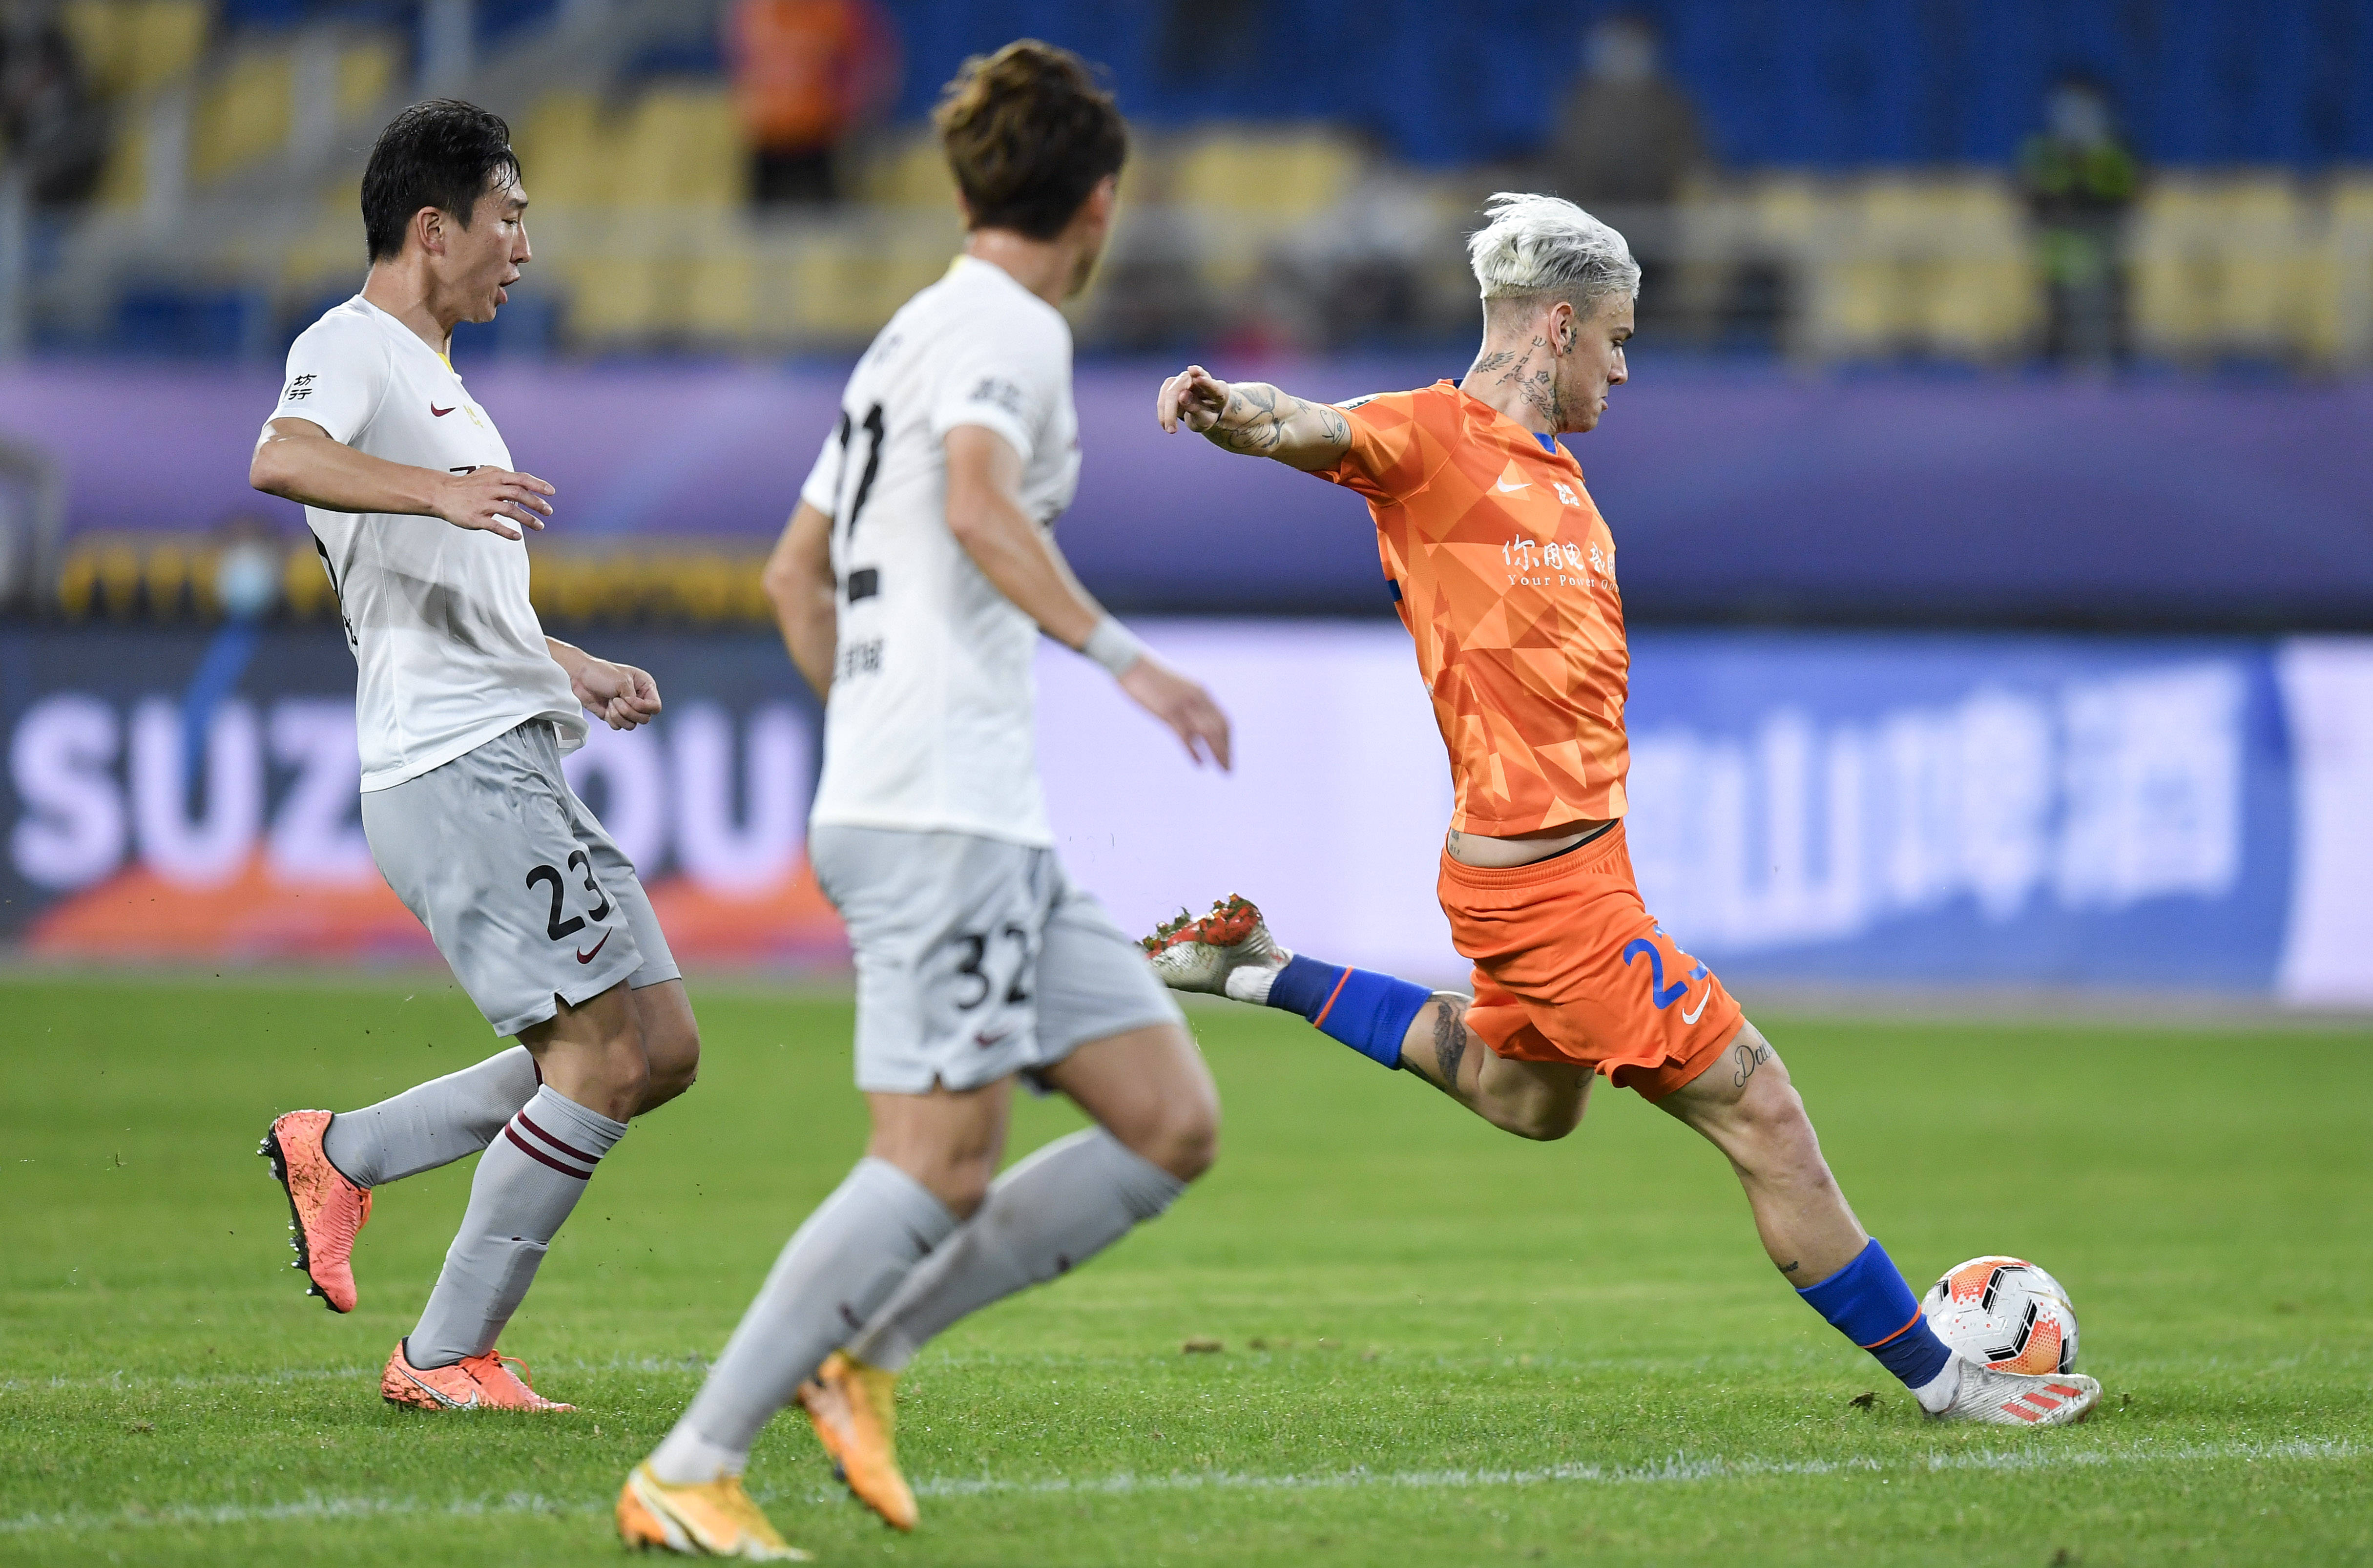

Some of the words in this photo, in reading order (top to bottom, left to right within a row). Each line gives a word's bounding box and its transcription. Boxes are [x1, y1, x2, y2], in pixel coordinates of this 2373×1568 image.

[1507, 575, 1550, 585] Your
[1559, 575, 1595, 587] Power
[11, 692, 814, 895] SUZOU
[526, 850, 610, 941] 23
[951, 922, 1033, 1011] 32
